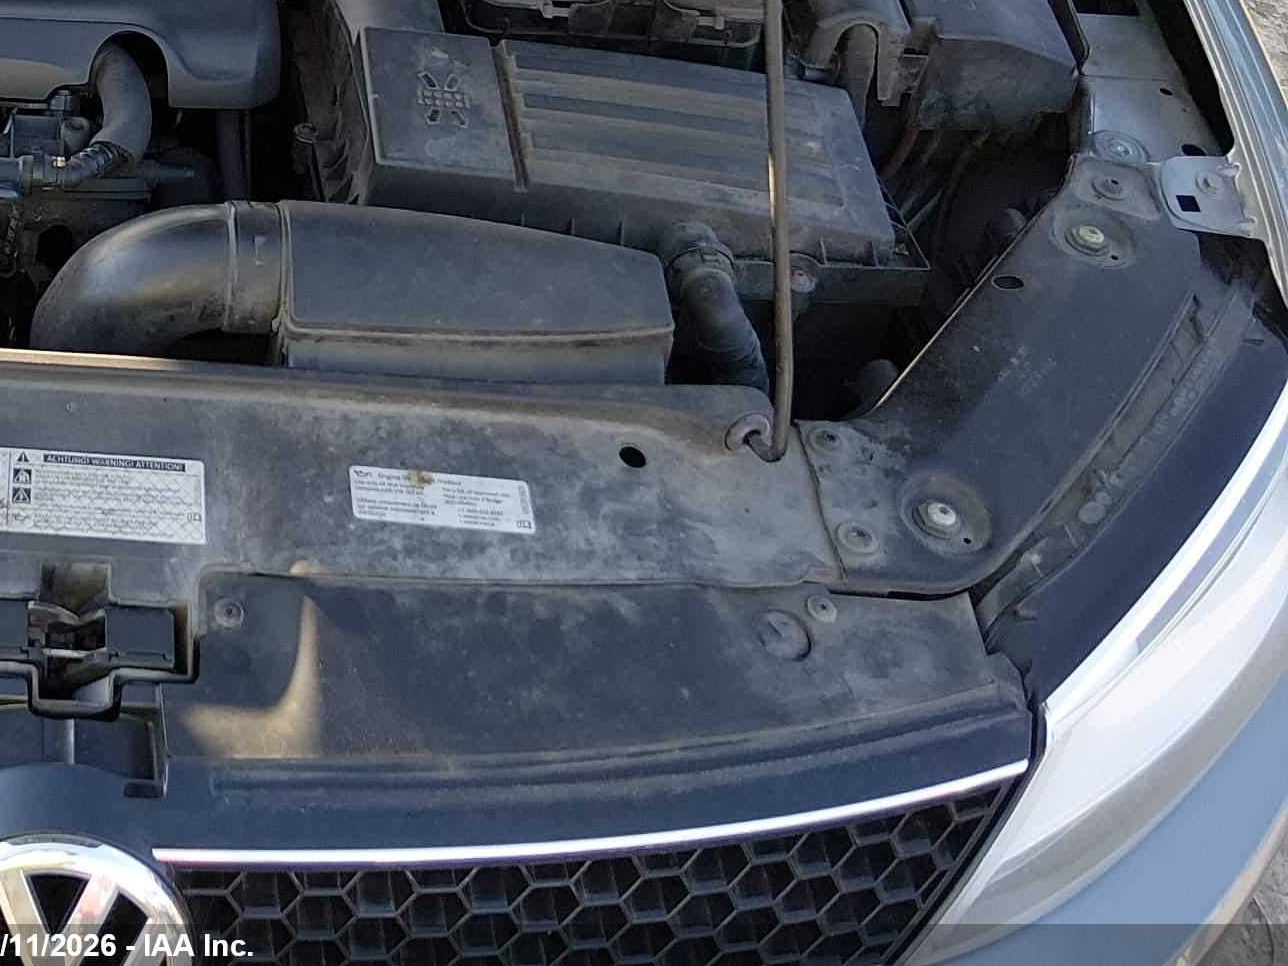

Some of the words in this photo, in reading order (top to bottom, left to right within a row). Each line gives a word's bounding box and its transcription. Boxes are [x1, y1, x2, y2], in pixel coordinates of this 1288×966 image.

[47, 454, 90, 465] ACHTUNG!
[92, 457, 134, 468] WARNING!
[135, 460, 184, 472] ATTENTION!
